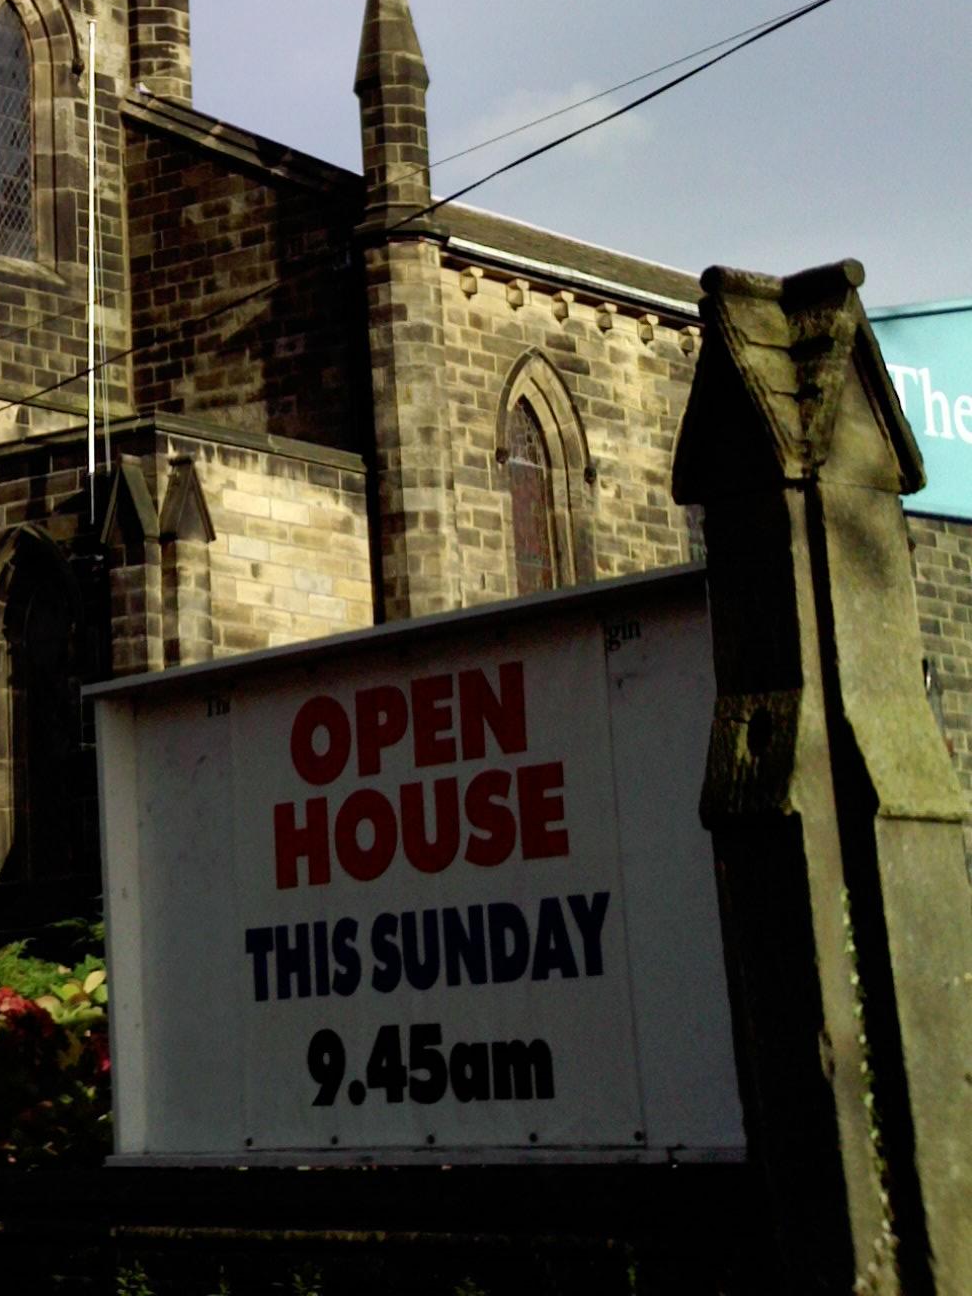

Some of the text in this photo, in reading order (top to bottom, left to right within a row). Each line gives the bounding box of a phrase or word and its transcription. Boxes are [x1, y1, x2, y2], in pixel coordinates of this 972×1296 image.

[290, 661, 528, 786] OPEN
[273, 761, 570, 890] HOUSE
[245, 891, 611, 1002] THIS SUNDAY
[307, 1022, 556, 1106] 9.45am
